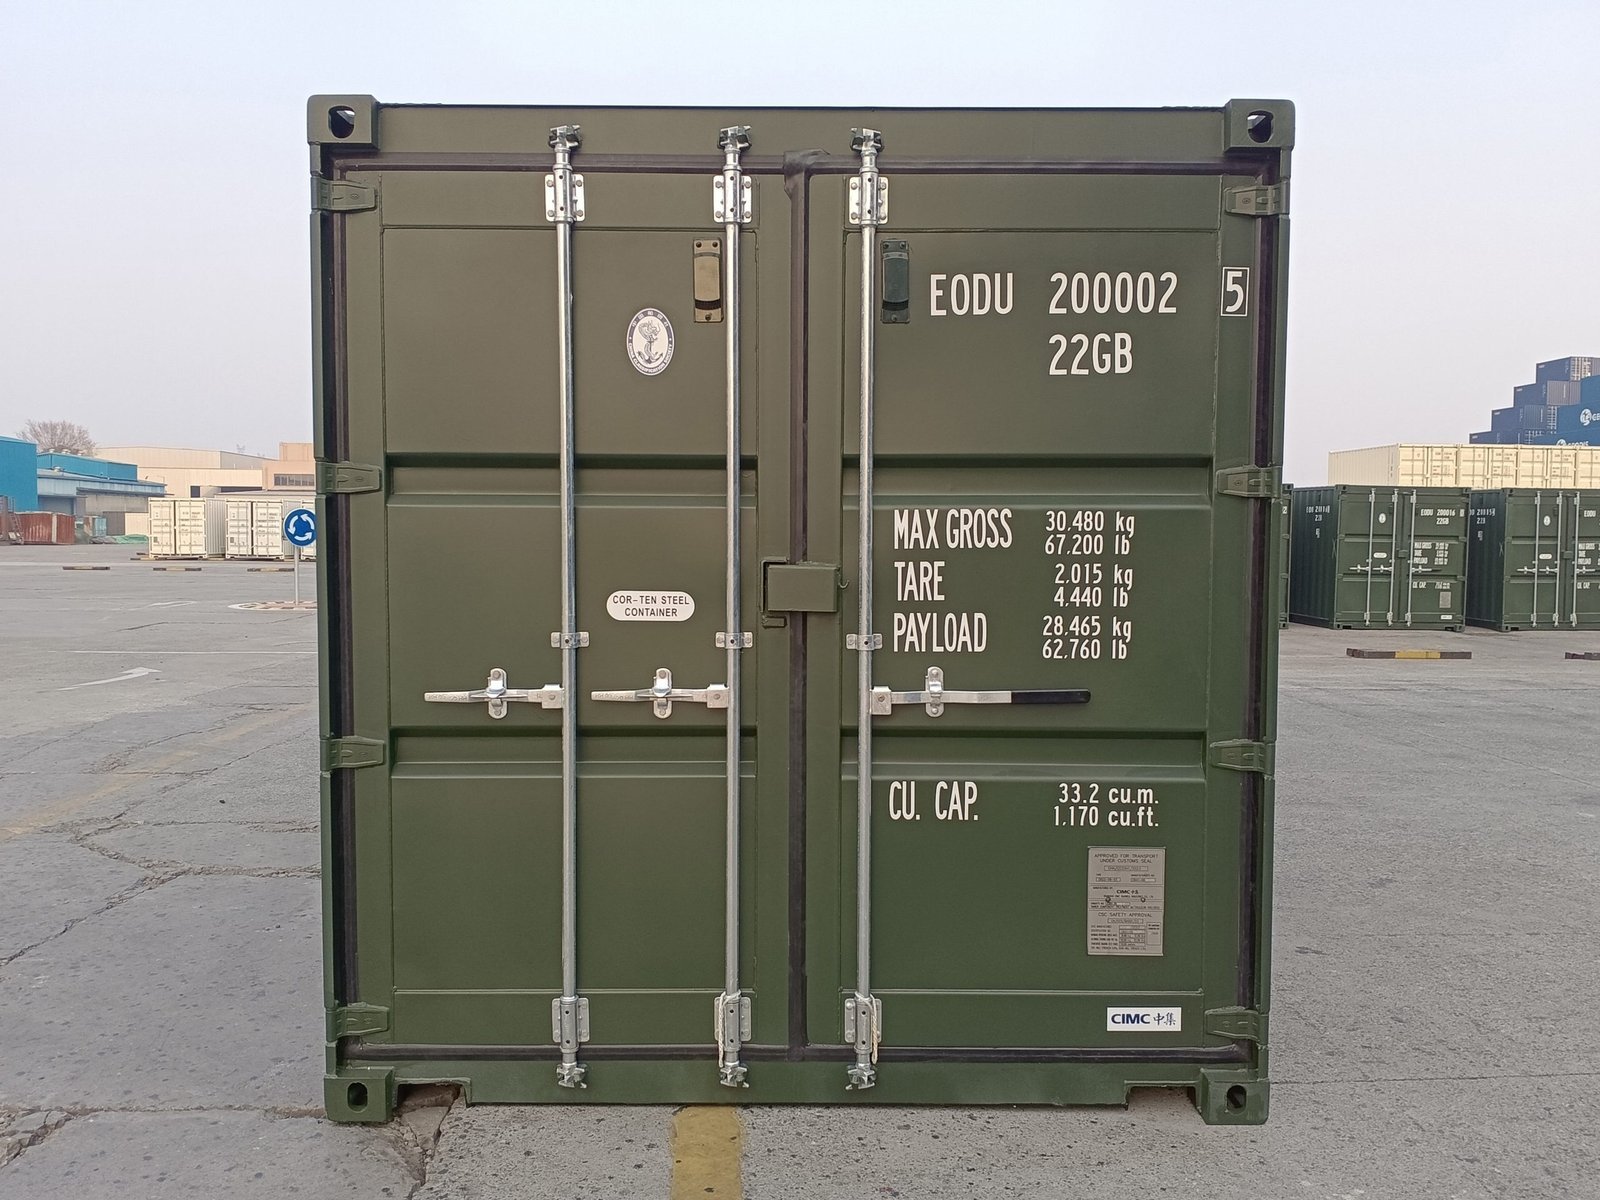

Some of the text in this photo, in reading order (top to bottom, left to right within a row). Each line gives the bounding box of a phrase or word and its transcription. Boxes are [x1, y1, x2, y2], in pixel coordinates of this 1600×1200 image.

[930, 271, 1245, 316] EODU 200002 5
[1048, 332, 1133, 376] 22GB
[893, 508, 1013, 550] MAX GROSS
[1045, 510, 1135, 538] 30,480 kg
[1044, 534, 1131, 555] 67,200 lb
[894, 561, 946, 602] TARE
[1054, 563, 1133, 591] 2,015 kg
[661, 595, 690, 605] STEEL
[1053, 586, 1130, 608] 4,440 lb
[624, 607, 678, 617] CONTAINER
[893, 612, 987, 653] PAYLOAD
[1042, 615, 1132, 643] 28,465 kg
[1042, 639, 1128, 660] 62,760 lb
[889, 780, 979, 821] CU. CAP.
[1058, 782, 1159, 804] 33.2 cu.m.
[1053, 806, 1159, 827] 1,170 cu.ft.
[1110, 1012, 1177, 1027] CIMC 中集
